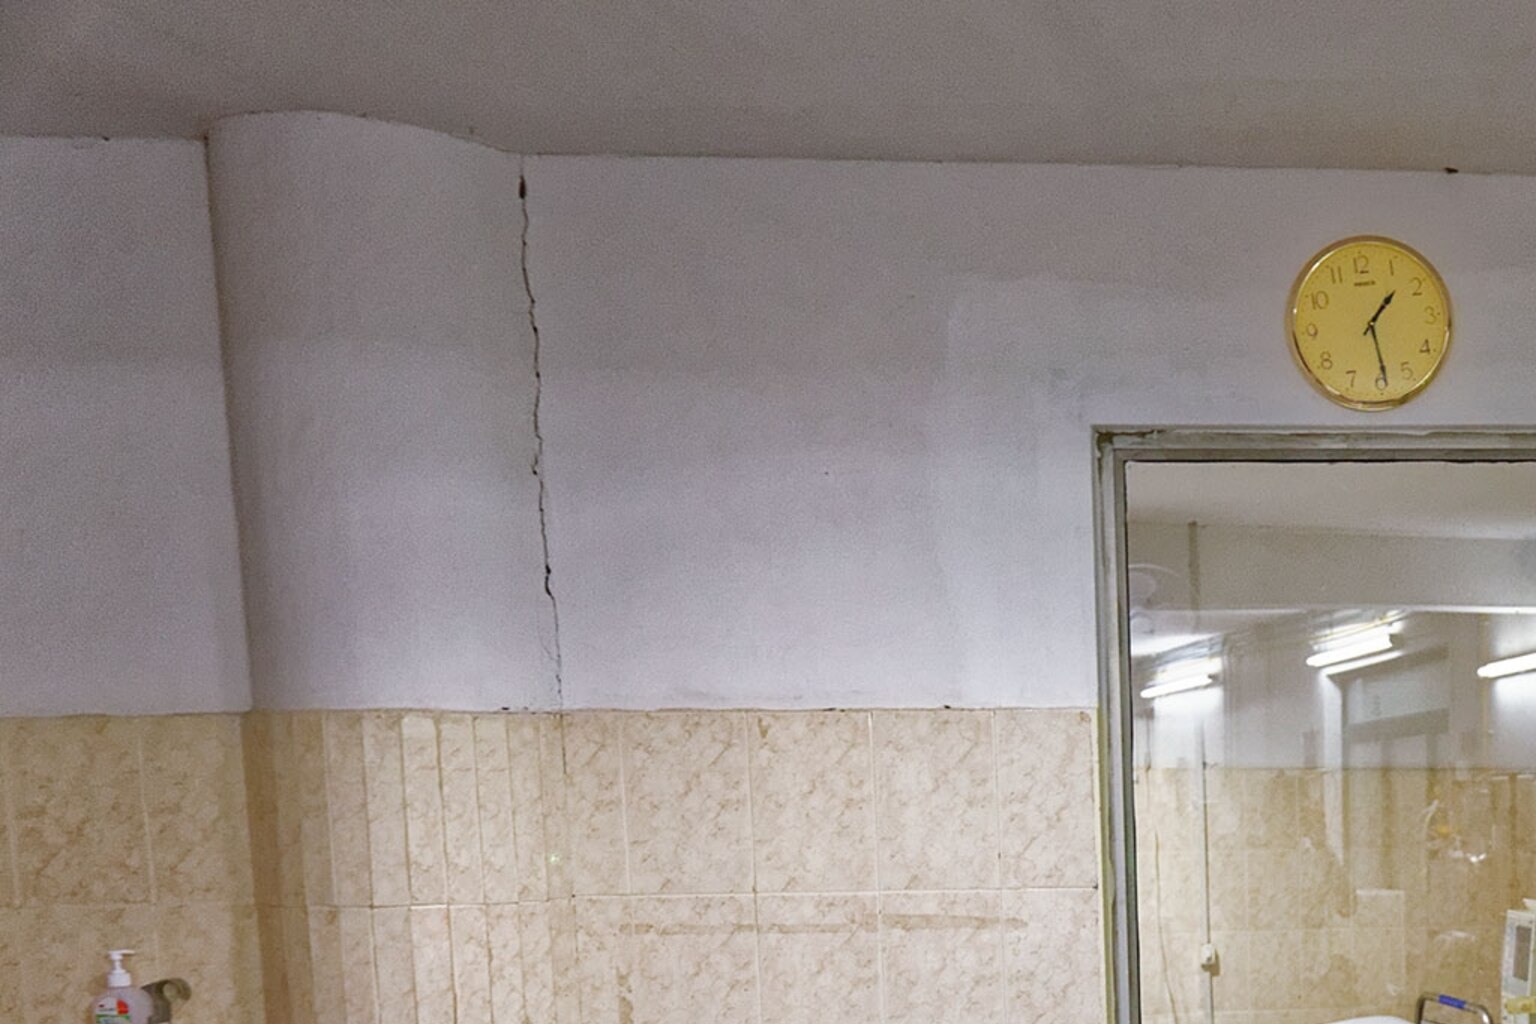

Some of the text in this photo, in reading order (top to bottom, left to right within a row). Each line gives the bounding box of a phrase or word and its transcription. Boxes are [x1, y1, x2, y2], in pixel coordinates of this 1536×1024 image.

[1353, 255, 1369, 274] 12
[1389, 260, 1394, 276] 1
[1330, 266, 1343, 284] 11
[1410, 277, 1422, 296] 2
[1311, 290, 1329, 310] 10
[1425, 306, 1437, 325] 3
[1307, 323, 1318, 340] 9
[1420, 339, 1431, 355] 4
[1321, 352, 1333, 370] 8
[1345, 370, 1356, 388] 7
[1401, 361, 1413, 381] 5
